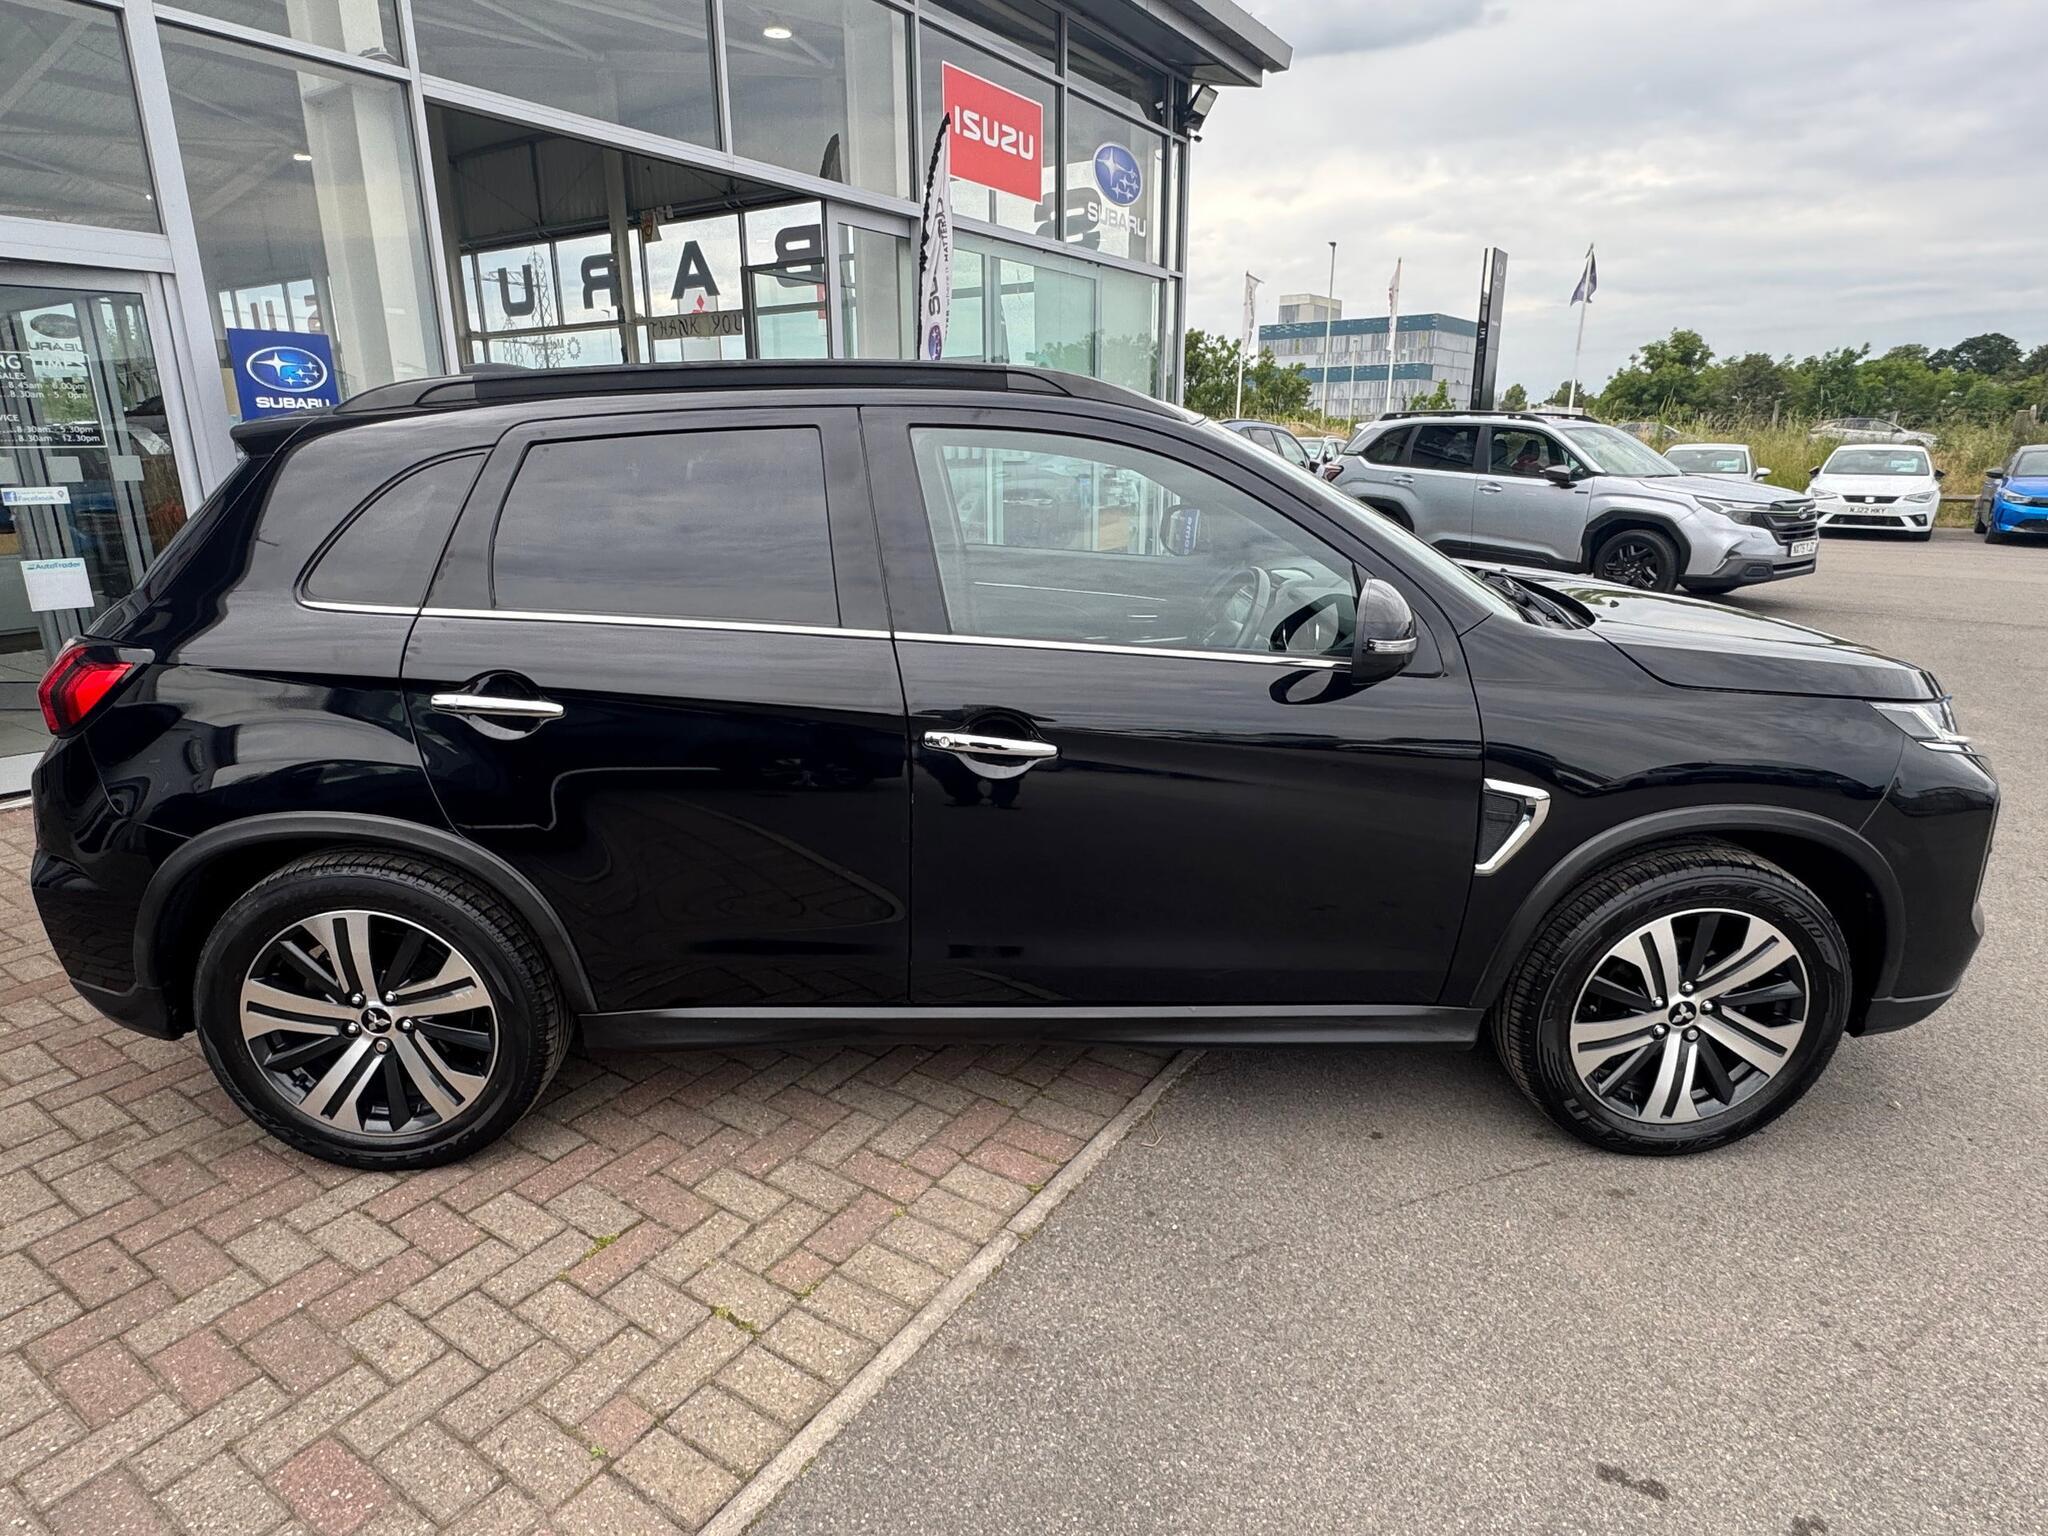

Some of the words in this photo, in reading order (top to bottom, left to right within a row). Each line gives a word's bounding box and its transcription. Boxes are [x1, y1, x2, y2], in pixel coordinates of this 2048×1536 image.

[954, 105, 1034, 160] ISUZU
[1087, 201, 1147, 238] SUBARU
[649, 317, 700, 337] THANK
[711, 314, 742, 334] YOU
[256, 396, 330, 410] SUBARU
[62, 434, 101, 443] 12.30pm
